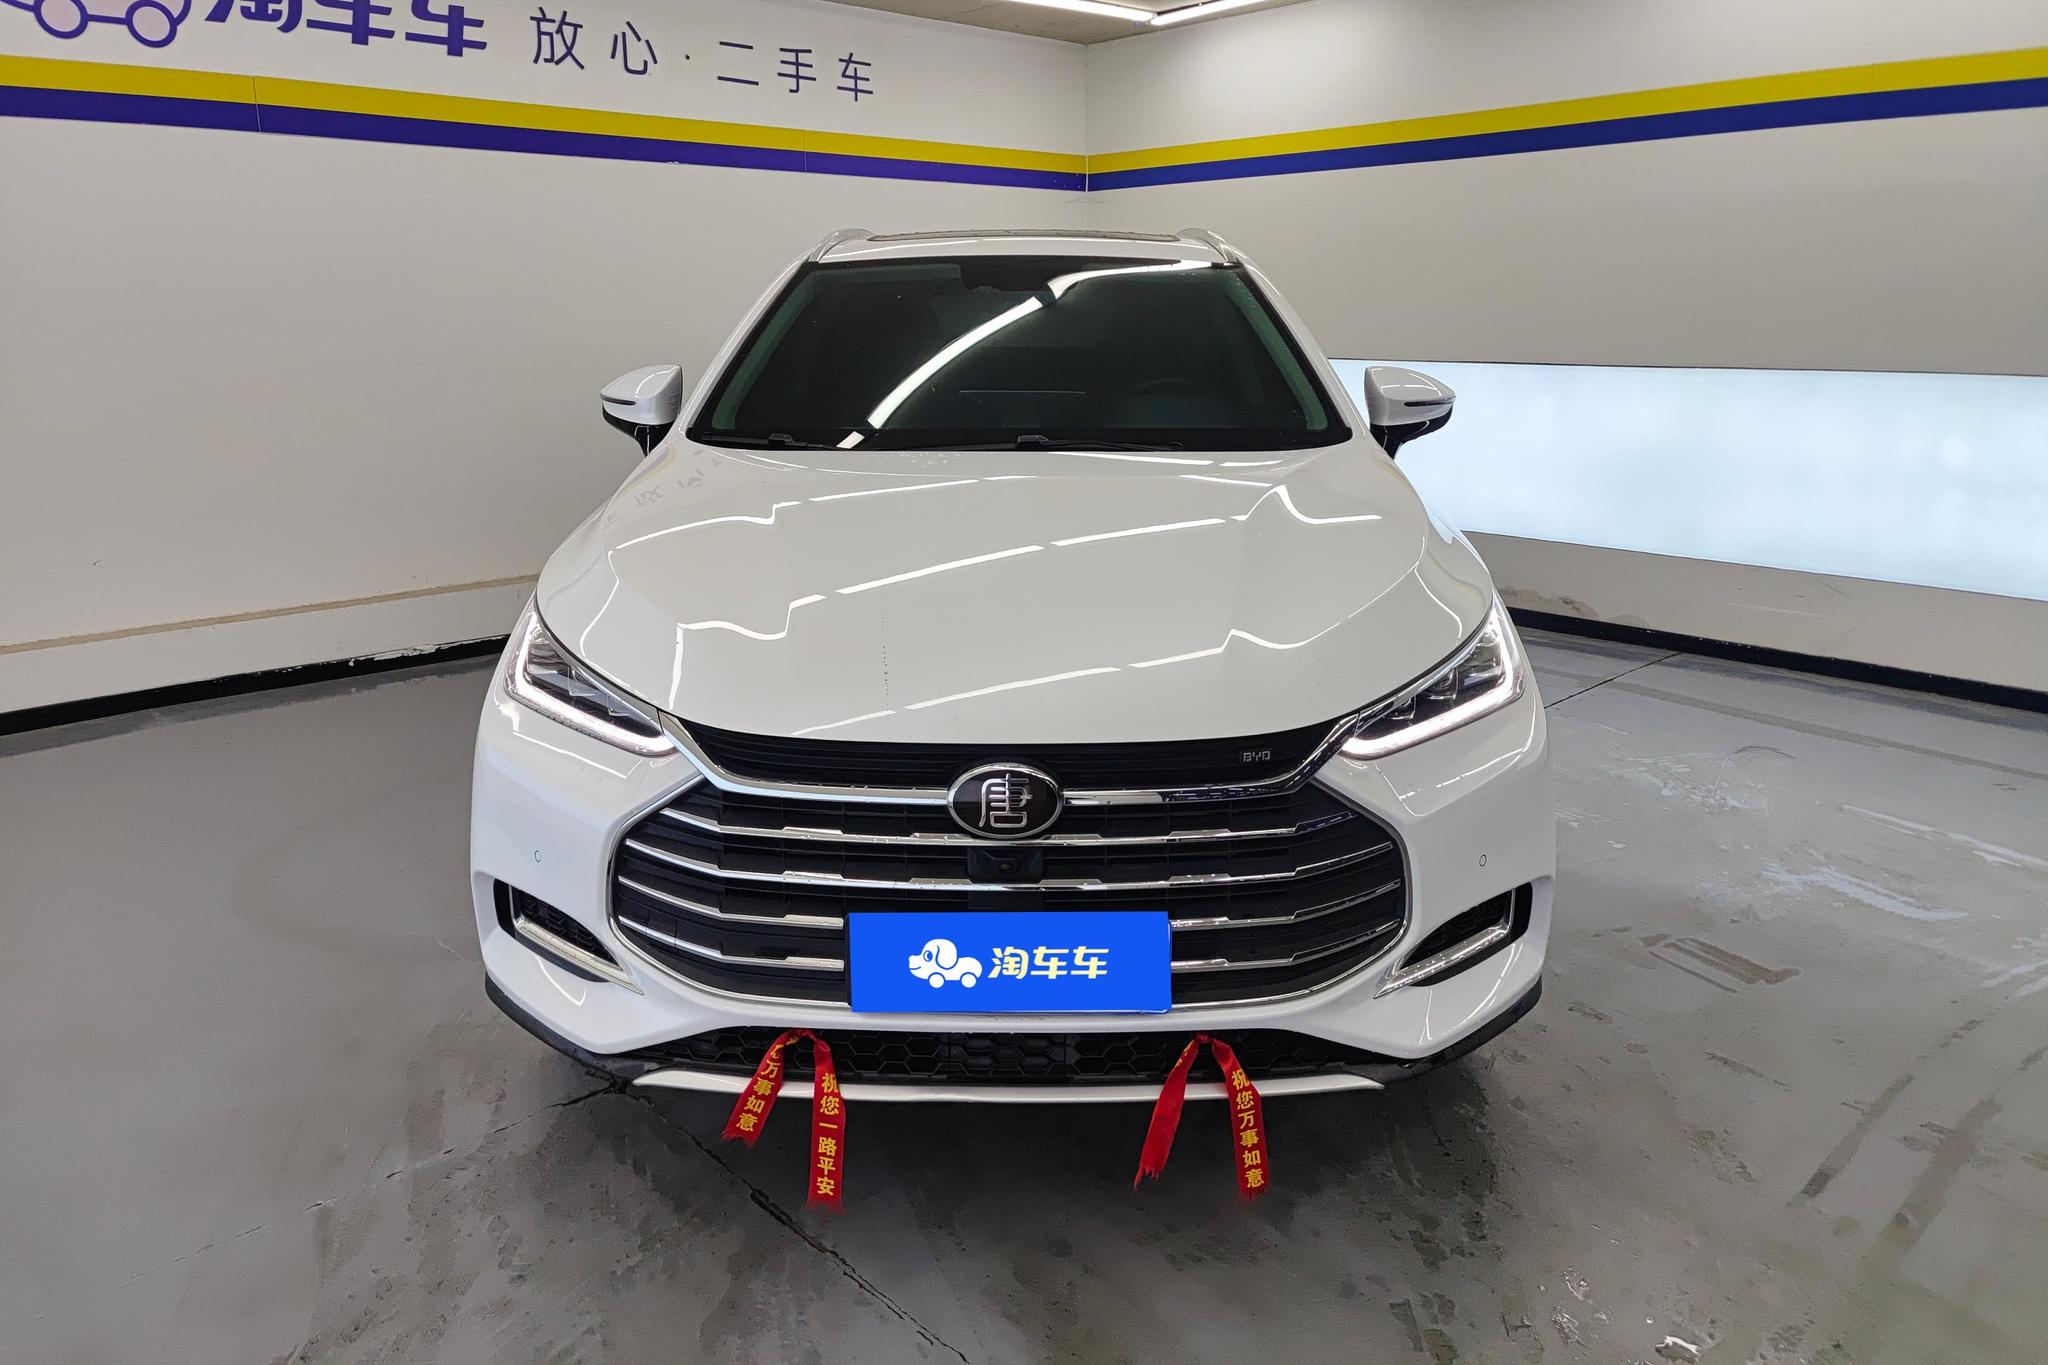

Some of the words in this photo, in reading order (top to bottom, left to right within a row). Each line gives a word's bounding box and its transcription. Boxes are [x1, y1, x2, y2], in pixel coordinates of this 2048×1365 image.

[979, 772, 1033, 828] 唐
[1243, 751, 1271, 762] BYD
[735, 1035, 799, 1132] 万事如意
[1231, 1069, 1265, 1189] 祝您万事如意
[816, 1072, 841, 1196] 祝您一路平安
